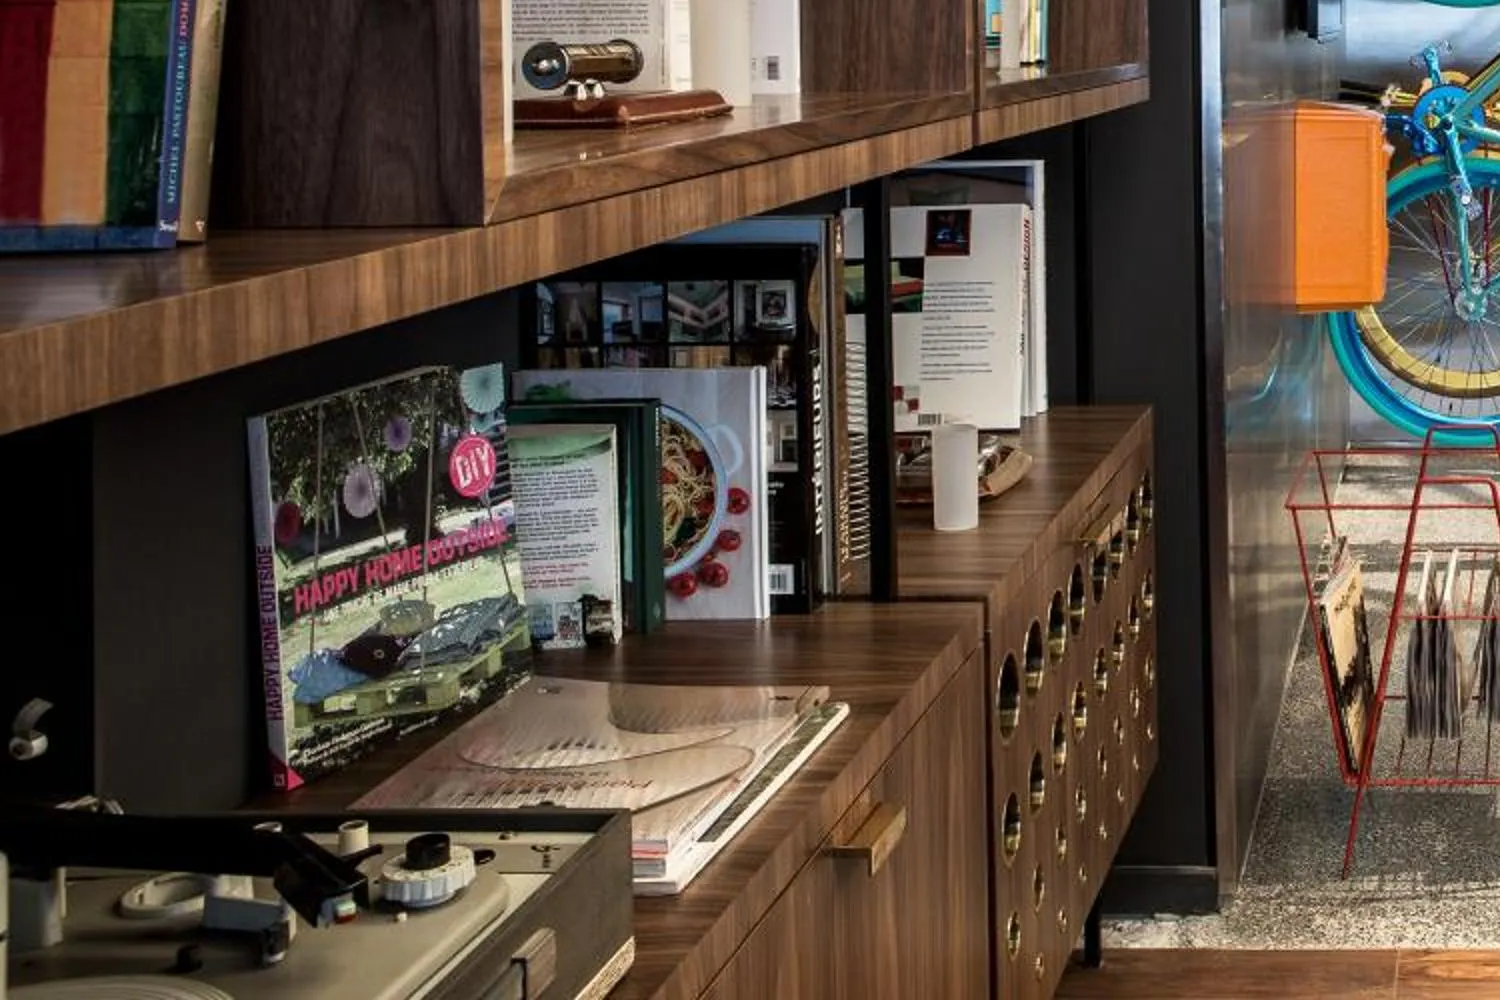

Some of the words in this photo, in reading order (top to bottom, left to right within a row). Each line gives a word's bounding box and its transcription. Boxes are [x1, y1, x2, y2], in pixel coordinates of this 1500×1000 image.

[172, 40, 189, 138] PASTOUREAU
[167, 143, 181, 204] MICHEL
[455, 441, 492, 490] DIY
[255, 544, 276, 613] OUTSIDE
[293, 563, 360, 616] HAPPY
[364, 543, 424, 588] HOME
[426, 516, 512, 567] OUTSIDE
[260, 616, 279, 663] HOME
[264, 668, 284, 721] HAPPY
